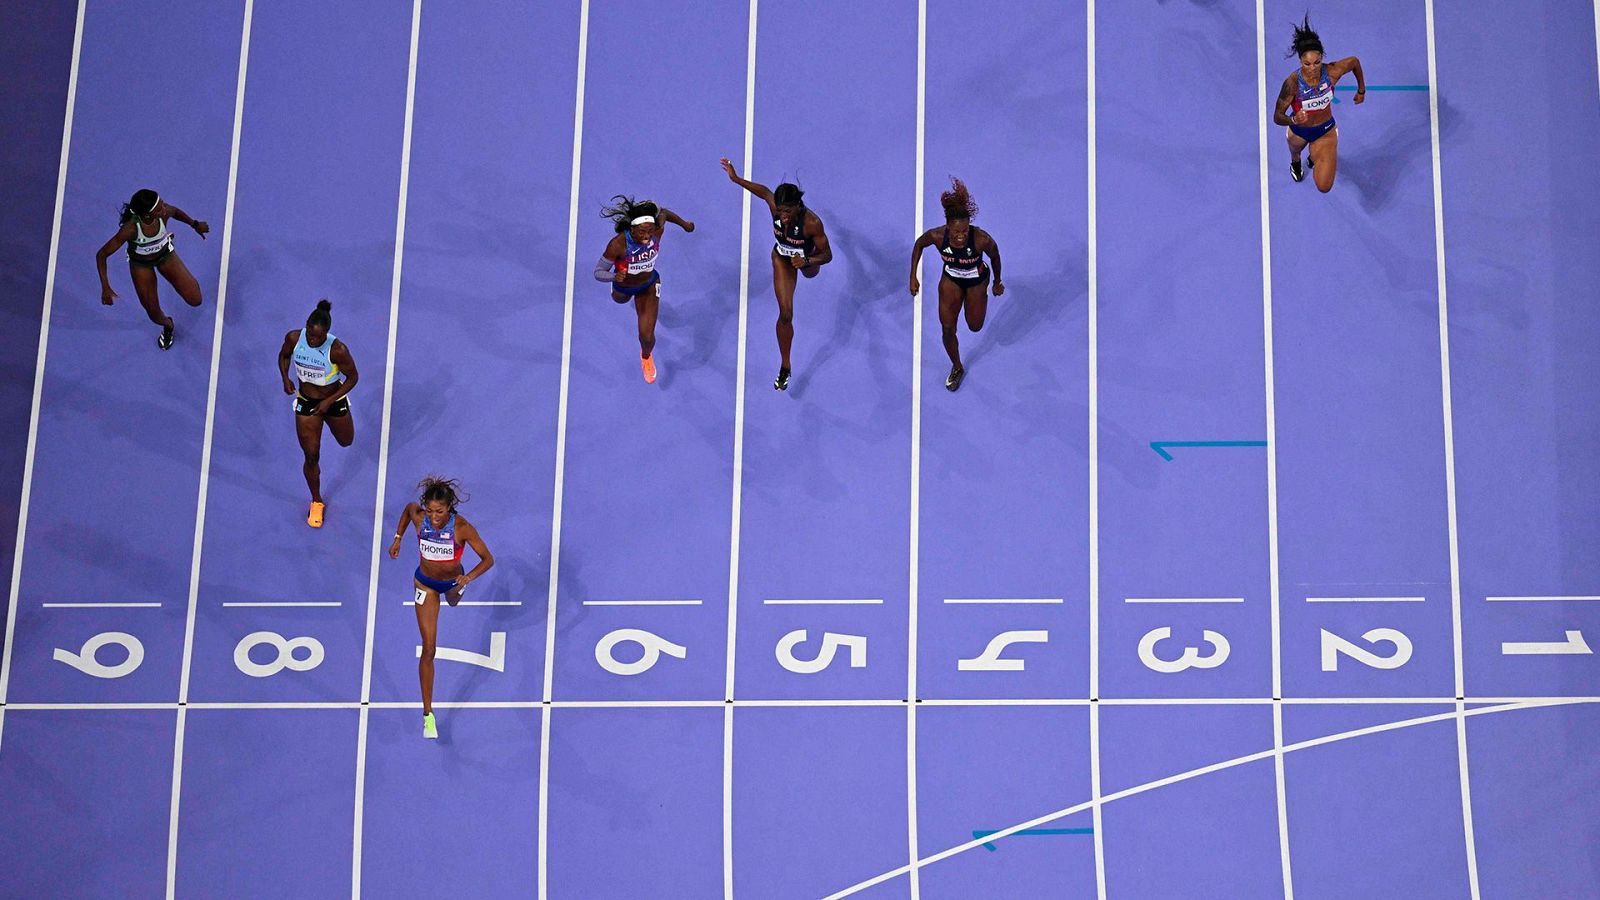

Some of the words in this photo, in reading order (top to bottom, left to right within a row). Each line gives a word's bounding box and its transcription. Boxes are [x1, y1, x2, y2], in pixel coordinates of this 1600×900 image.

[631, 249, 658, 262] USA
[421, 543, 453, 555] THOMAS
[416, 591, 422, 600] 7
[53, 631, 145, 679] 9
[233, 631, 325, 678] 8
[415, 631, 507, 673] 7
[594, 628, 687, 676] 6
[774, 628, 868, 675] 5
[957, 629, 1049, 672] 4
[1137, 626, 1231, 674] 3
[1320, 627, 1414, 673] 2
[1501, 629, 1594, 655] 1
